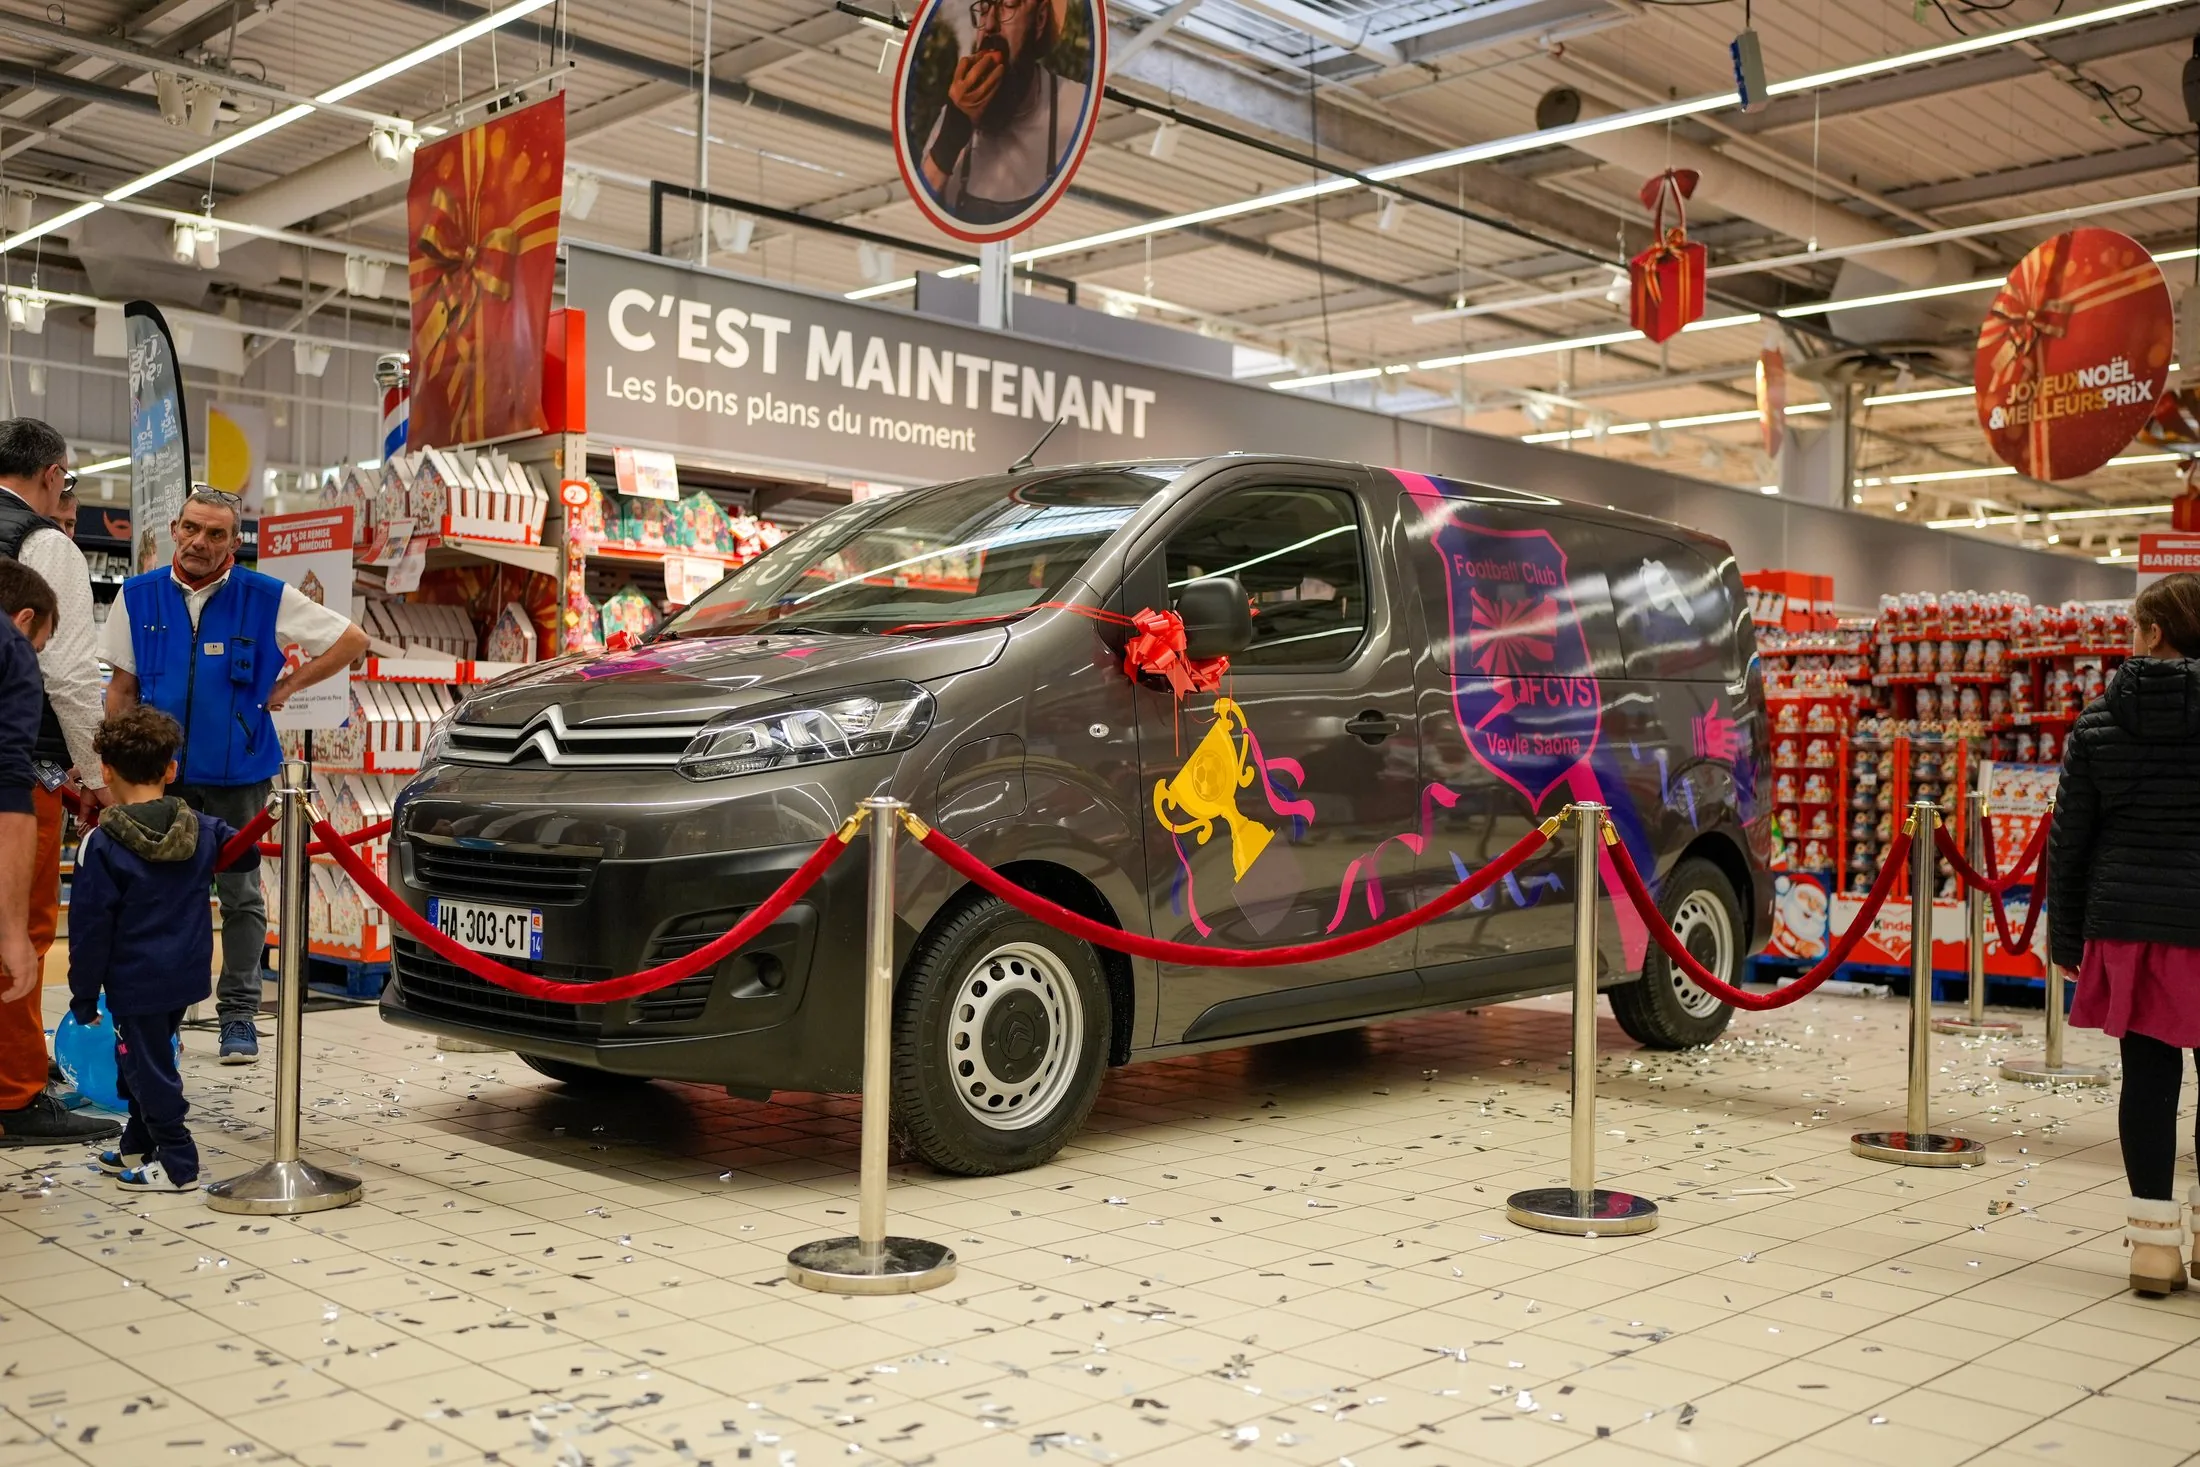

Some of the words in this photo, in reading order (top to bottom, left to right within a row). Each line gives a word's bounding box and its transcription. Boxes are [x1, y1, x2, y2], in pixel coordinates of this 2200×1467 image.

[607, 288, 791, 374] C'EST
[805, 325, 1156, 438] MAINTENANT
[606, 366, 656, 403] Les
[666, 377, 738, 415] bons
[746, 391, 820, 427] plans
[827, 407, 861, 435] du
[870, 418, 976, 453] moment
[1453, 554, 1519, 582] Football
[1521, 562, 1557, 586] Club
[2143, 553, 2200, 567] BARRES
[1485, 732, 1530, 761] Veyle
[1873, 919, 1912, 932] Kinde
[532, 936, 541, 952] 14
